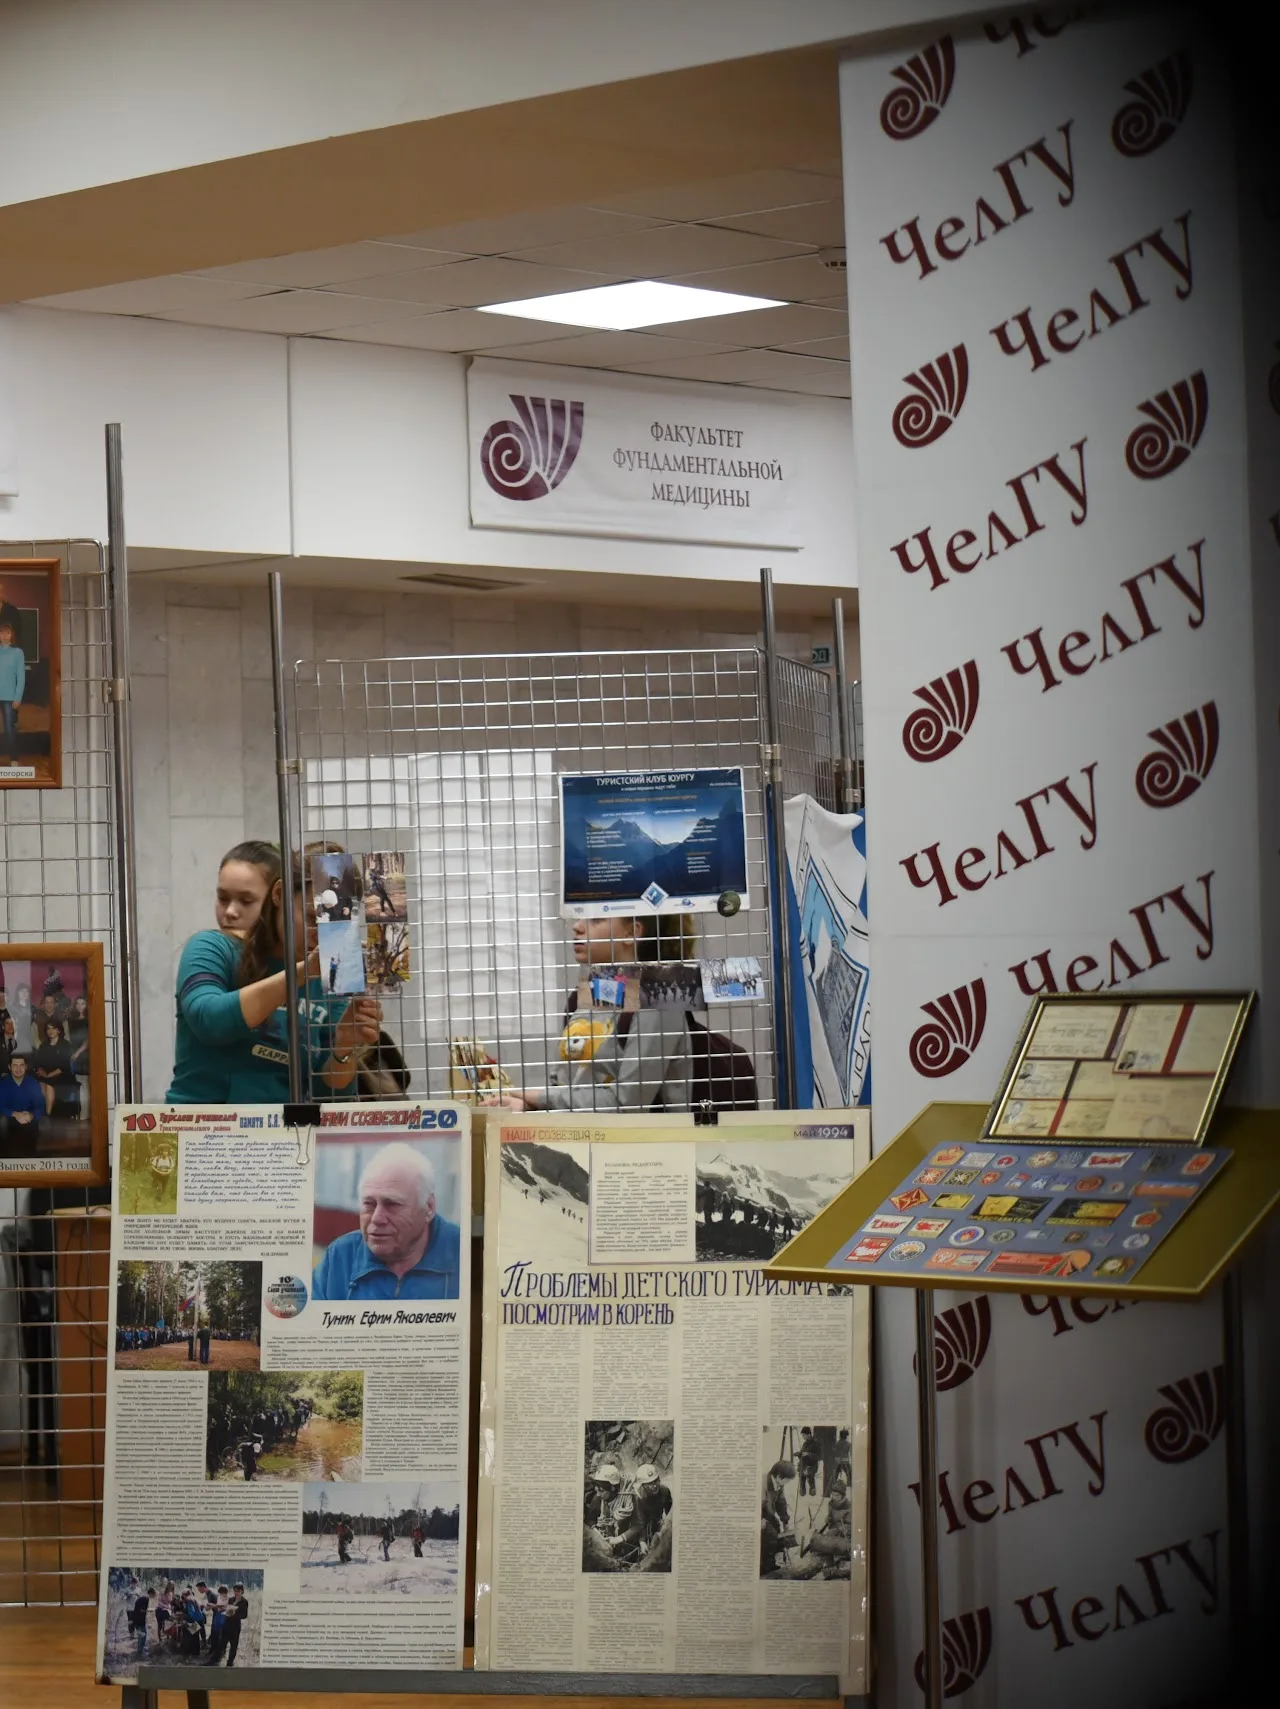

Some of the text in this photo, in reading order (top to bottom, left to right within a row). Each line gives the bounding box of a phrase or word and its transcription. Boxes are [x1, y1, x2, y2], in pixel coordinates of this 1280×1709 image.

[880, 119, 1075, 279] ЧелГУ
[989, 210, 1192, 372] ЧелГУ
[650, 422, 744, 449] ФАКУЛЬТЕТ
[613, 448, 784, 481] ФУНДАМЕНТАЛЬНОЙ
[651, 482, 750, 510] МЕДИЦИНЫ
[891, 436, 1088, 591] ЧелГУ
[1000, 538, 1207, 693] ЧелГУ
[596, 773, 695, 786] ТУРИСТСКИЙ КЛУБ ЮУРГУ
[899, 762, 1098, 907] ЧелГУ
[122, 1113, 158, 1131] 10
[239, 1116, 264, 1128] памяти
[506, 1130, 536, 1141] НАШИ
[539, 1129, 591, 1141] СОЗВЕЗДИЯ
[818, 1126, 848, 1138] 1994
[39, 1160, 63, 1170] 2013
[65, 1161, 89, 1172] года
[622, 1269, 727, 1299] ДЕТСКОГО
[322, 1309, 457, 1328] Туник Ефим Яковлевич
[503, 1302, 675, 1326] ПОСМОТРИМ В КОРЕНЬ
[908, 1411, 1108, 1535] ЧелГУ
[1014, 1529, 1224, 1652] ЧелГУ
